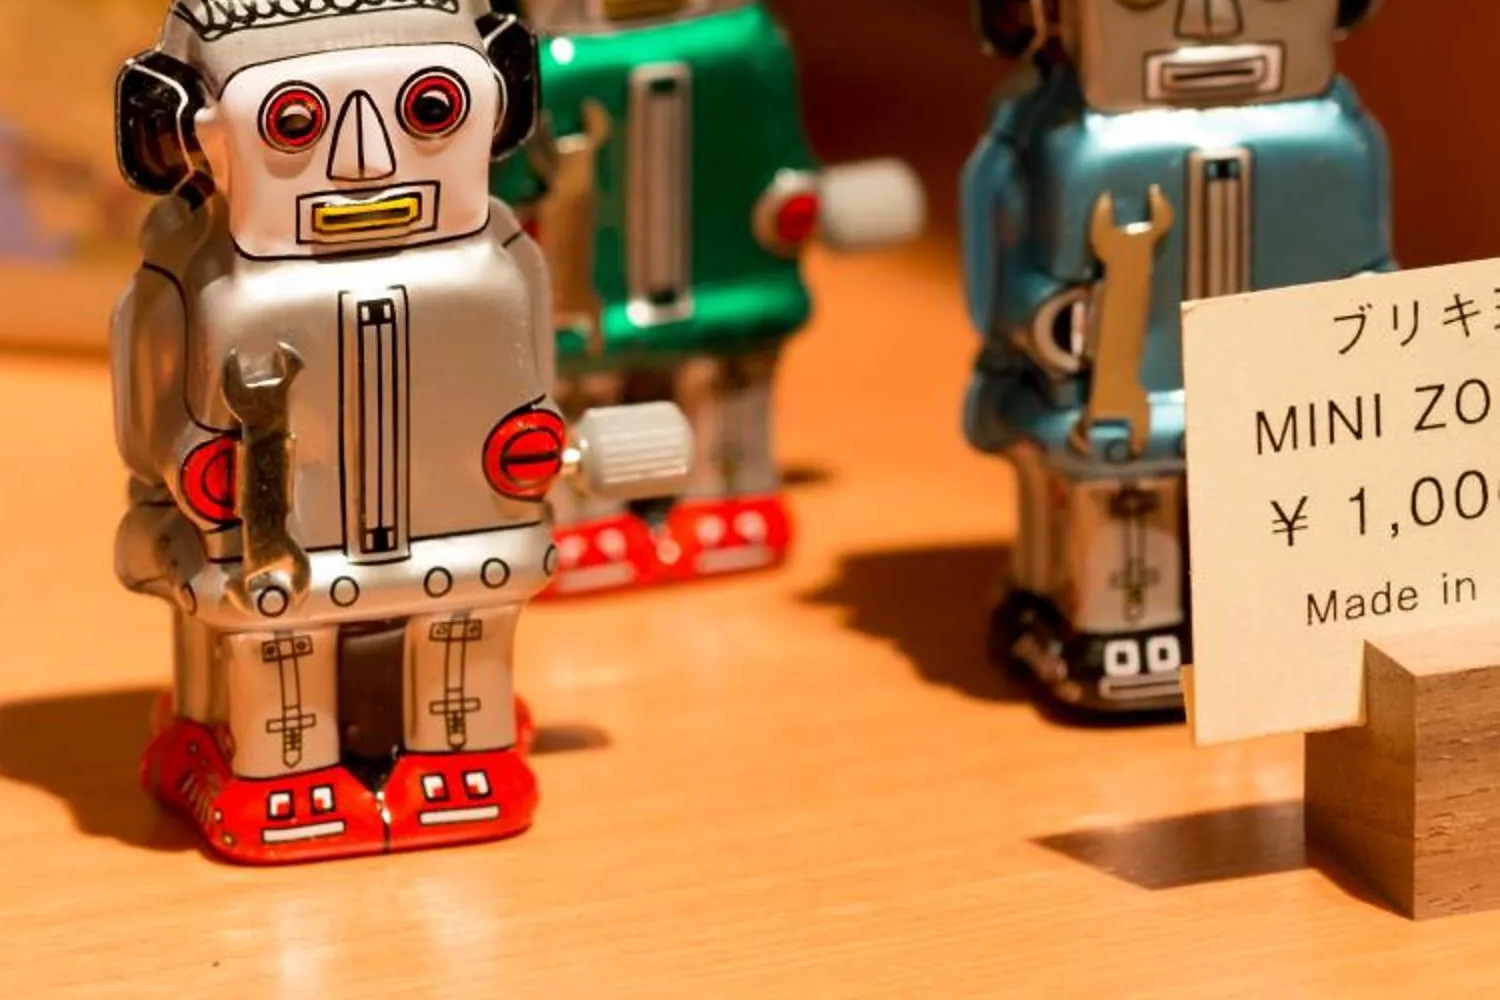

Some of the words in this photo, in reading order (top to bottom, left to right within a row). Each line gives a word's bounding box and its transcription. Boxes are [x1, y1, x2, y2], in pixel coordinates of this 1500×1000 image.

[1333, 287, 1500, 355] ブリキ
[1255, 392, 1382, 455] MINI
[1414, 378, 1491, 431] ZO
[1349, 469, 1500, 539] 1,00
[1306, 581, 1419, 626] Made
[1442, 572, 1477, 605] in
